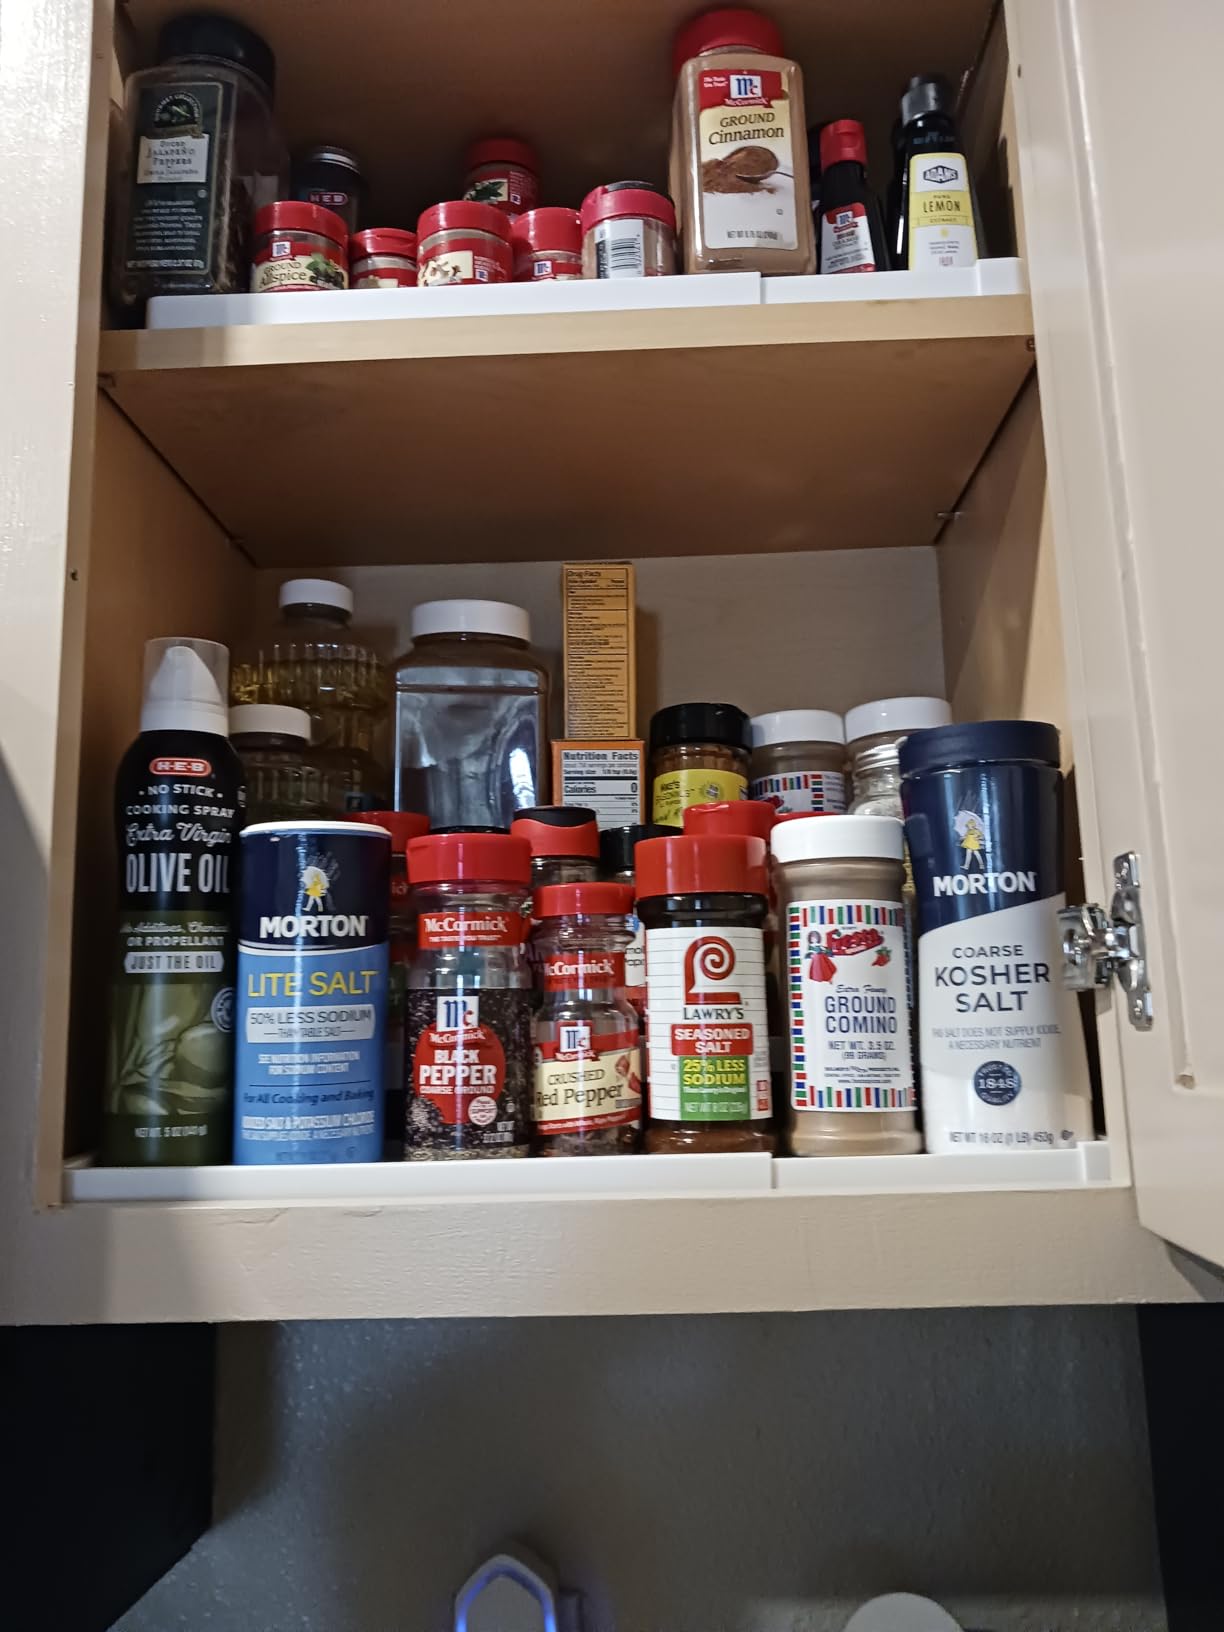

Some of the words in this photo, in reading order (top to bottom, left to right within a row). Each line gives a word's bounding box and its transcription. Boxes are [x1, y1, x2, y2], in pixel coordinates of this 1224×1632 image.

[720, 112, 775, 127] GROUND
[708, 127, 784, 145] Cinnamon
[923, 200, 960, 213] LEMON
[564, 752, 607, 761] Nutrition
[612, 752, 639, 760] Facts
[148, 785, 170, 795] NO
[173, 784, 215, 798] STICK
[564, 785, 597, 794] Calories
[631, 782, 638, 793] 0
[126, 804, 190, 816] COOKING
[193, 805, 235, 819] SPRAY
[126, 822, 175, 847] Extra
[176, 822, 233, 848] Virgin
[126, 852, 192, 893] OLIVE
[198, 852, 229, 893] OIL
[932, 871, 1038, 897] MORTON
[259, 914, 368, 938] MORTON
[424, 916, 508, 933] McCormick
[145, 936, 224, 946] PROPELLANT
[952, 945, 1024, 958] COARSE
[131, 955, 162, 969] JUST
[166, 955, 190, 969] THE
[195, 955, 217, 969] OIL
[935, 963, 1050, 987] KOSHER
[248, 972, 302, 997] LITE
[309, 970, 378, 996] SALT
[825, 996, 896, 1014] GROUND
[956, 991, 1028, 1013] SALT
[251, 1012, 275, 1025] 50%
[277, 1011, 316, 1024] LESS
[317, 1009, 371, 1022] SODIUM
[683, 1008, 744, 1021] LAWRY'S
[826, 1016, 897, 1034] COMINO
[945, 1027, 961, 1038] SALT
[962, 1026, 984, 1037] DOES
[985, 1026, 1003, 1036] NOT
[1005, 1025, 1035, 1036] SUPPLY
[429, 1030, 486, 1043] McCormick
[674, 1028, 750, 1041] SEASONED
[695, 1041, 732, 1053] SALT
[828, 1041, 845, 1050] NET
[954, 1039, 1000, 1049] NECESSARY
[1002, 1038, 1041, 1048] NUTRIENT
[434, 1049, 480, 1063] BLACK
[555, 1050, 597, 1060] McCormick
[683, 1059, 715, 1072] 25%
[717, 1060, 745, 1071] LESS
[419, 1065, 497, 1085] PEPPER
[548, 1069, 605, 1085] CRUSHED
[683, 1074, 746, 1085] SODIUM
[257, 1092, 269, 1103] All
[272, 1092, 319, 1106] Cooking
[320, 1091, 340, 1102] and
[564, 1083, 624, 1108] Pepper
[949, 1132, 963, 1142] NET
[965, 1132, 976, 1142] WT
[991, 1132, 1003, 1143] OZ
